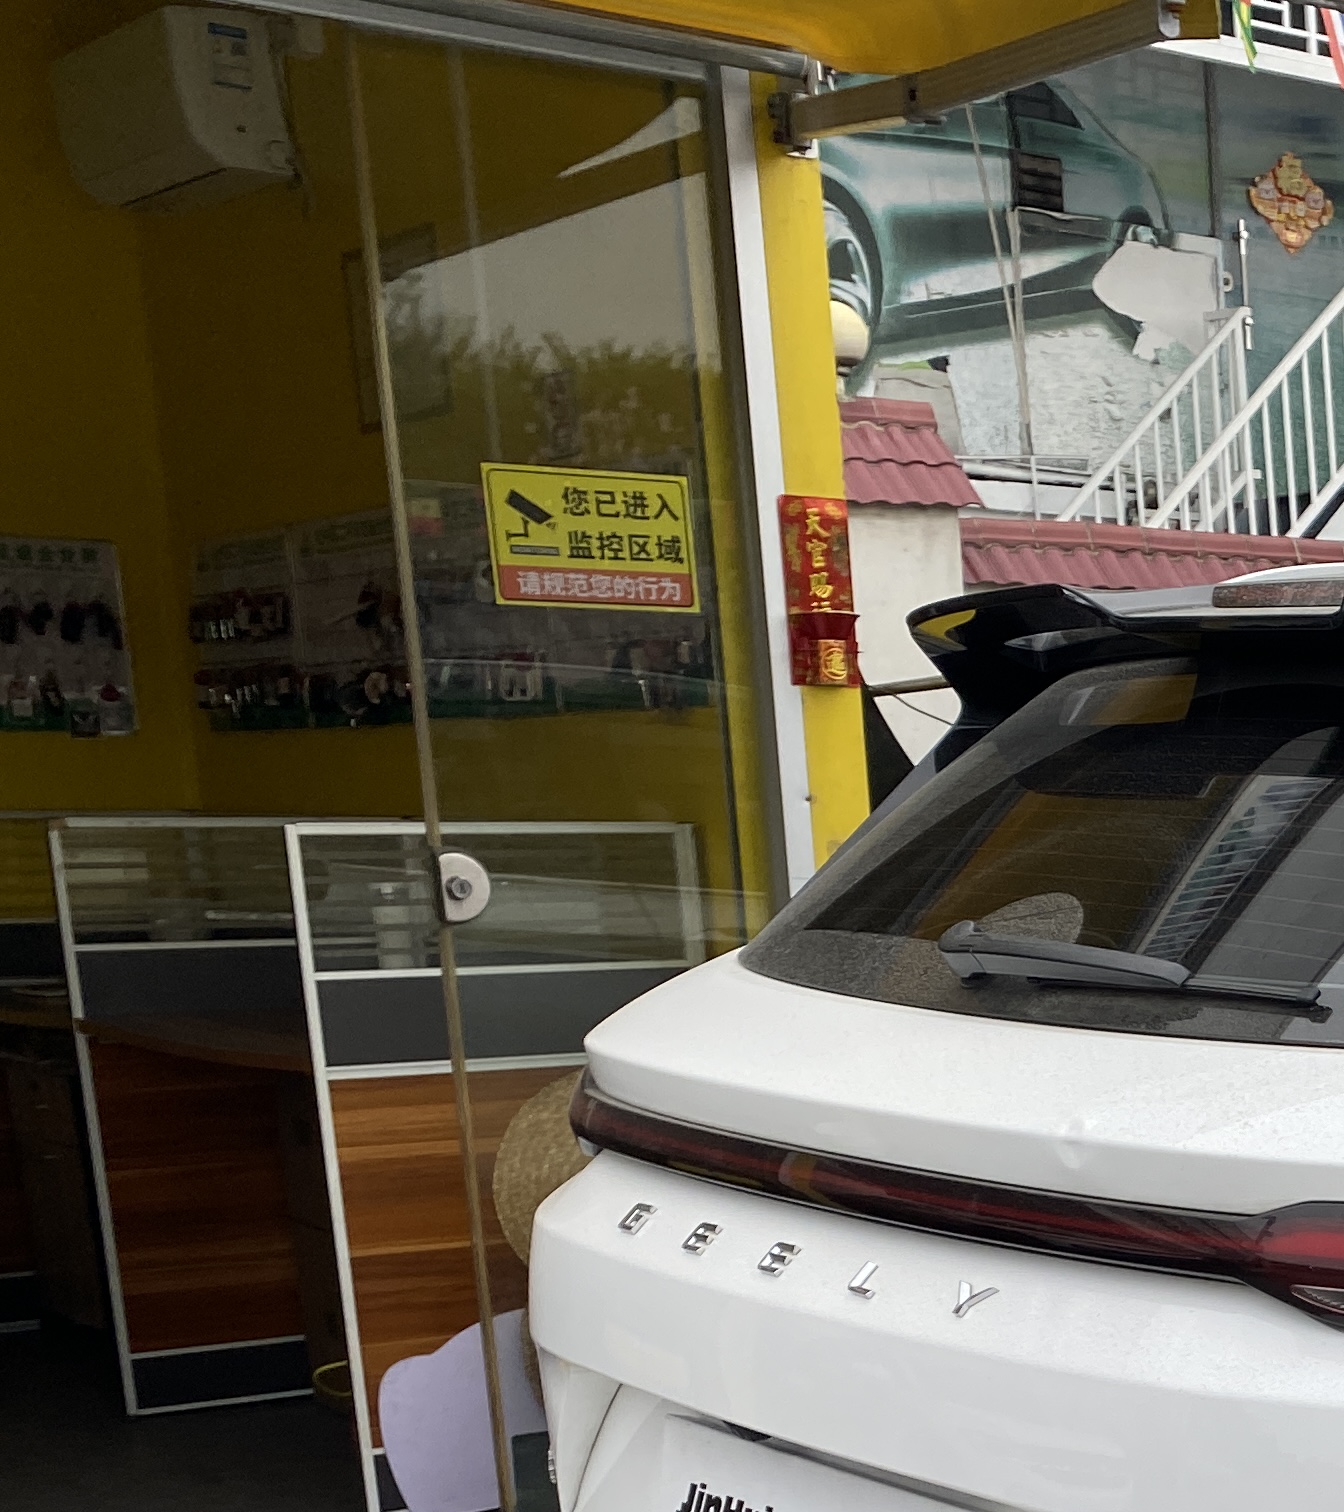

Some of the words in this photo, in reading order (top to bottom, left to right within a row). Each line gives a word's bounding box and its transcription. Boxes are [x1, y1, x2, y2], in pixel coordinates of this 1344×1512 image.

[561, 486, 680, 522] 您已进入
[567, 530, 684, 564] 监控区域
[516, 569, 682, 601] 请规范您的行为
[617, 1202, 1001, 1318] GEELY
